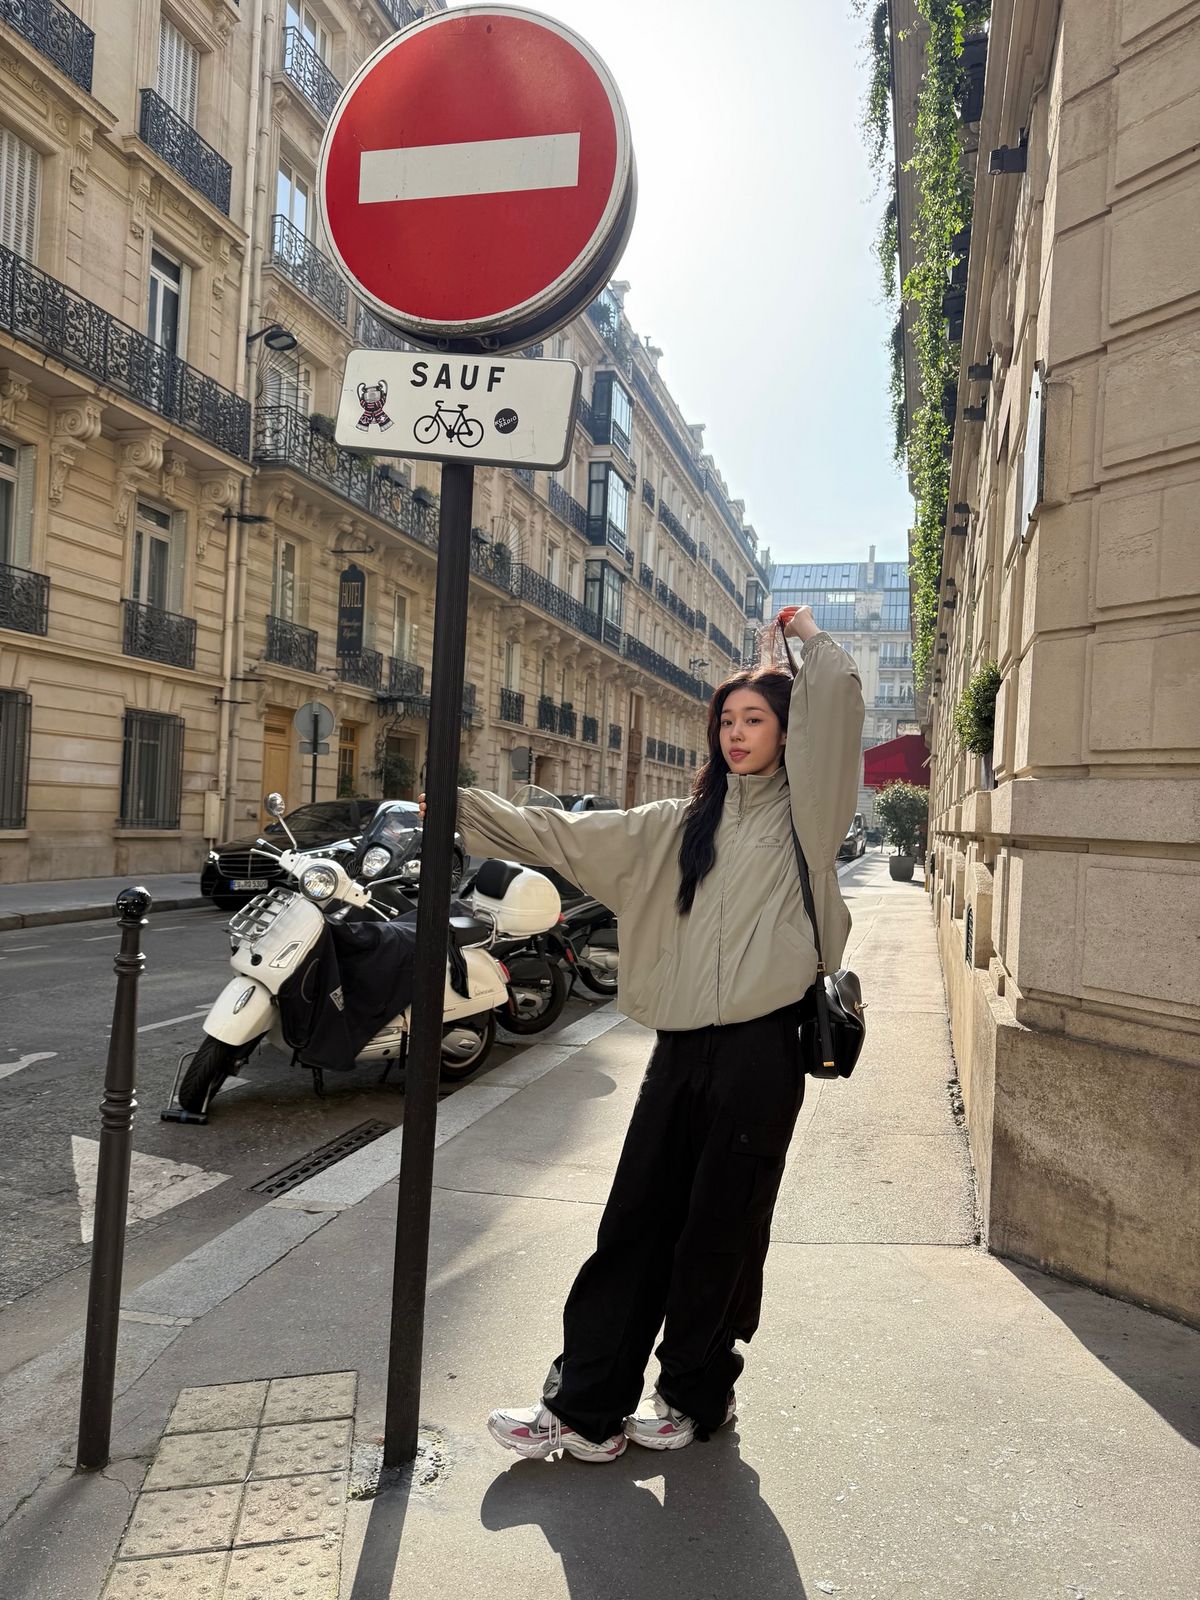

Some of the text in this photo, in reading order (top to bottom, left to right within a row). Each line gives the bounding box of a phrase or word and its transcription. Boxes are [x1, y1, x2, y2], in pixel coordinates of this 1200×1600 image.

[410, 362, 505, 392] SAUF
[498, 415, 518, 429] RADIO
[341, 582, 362, 608] HOTEL
